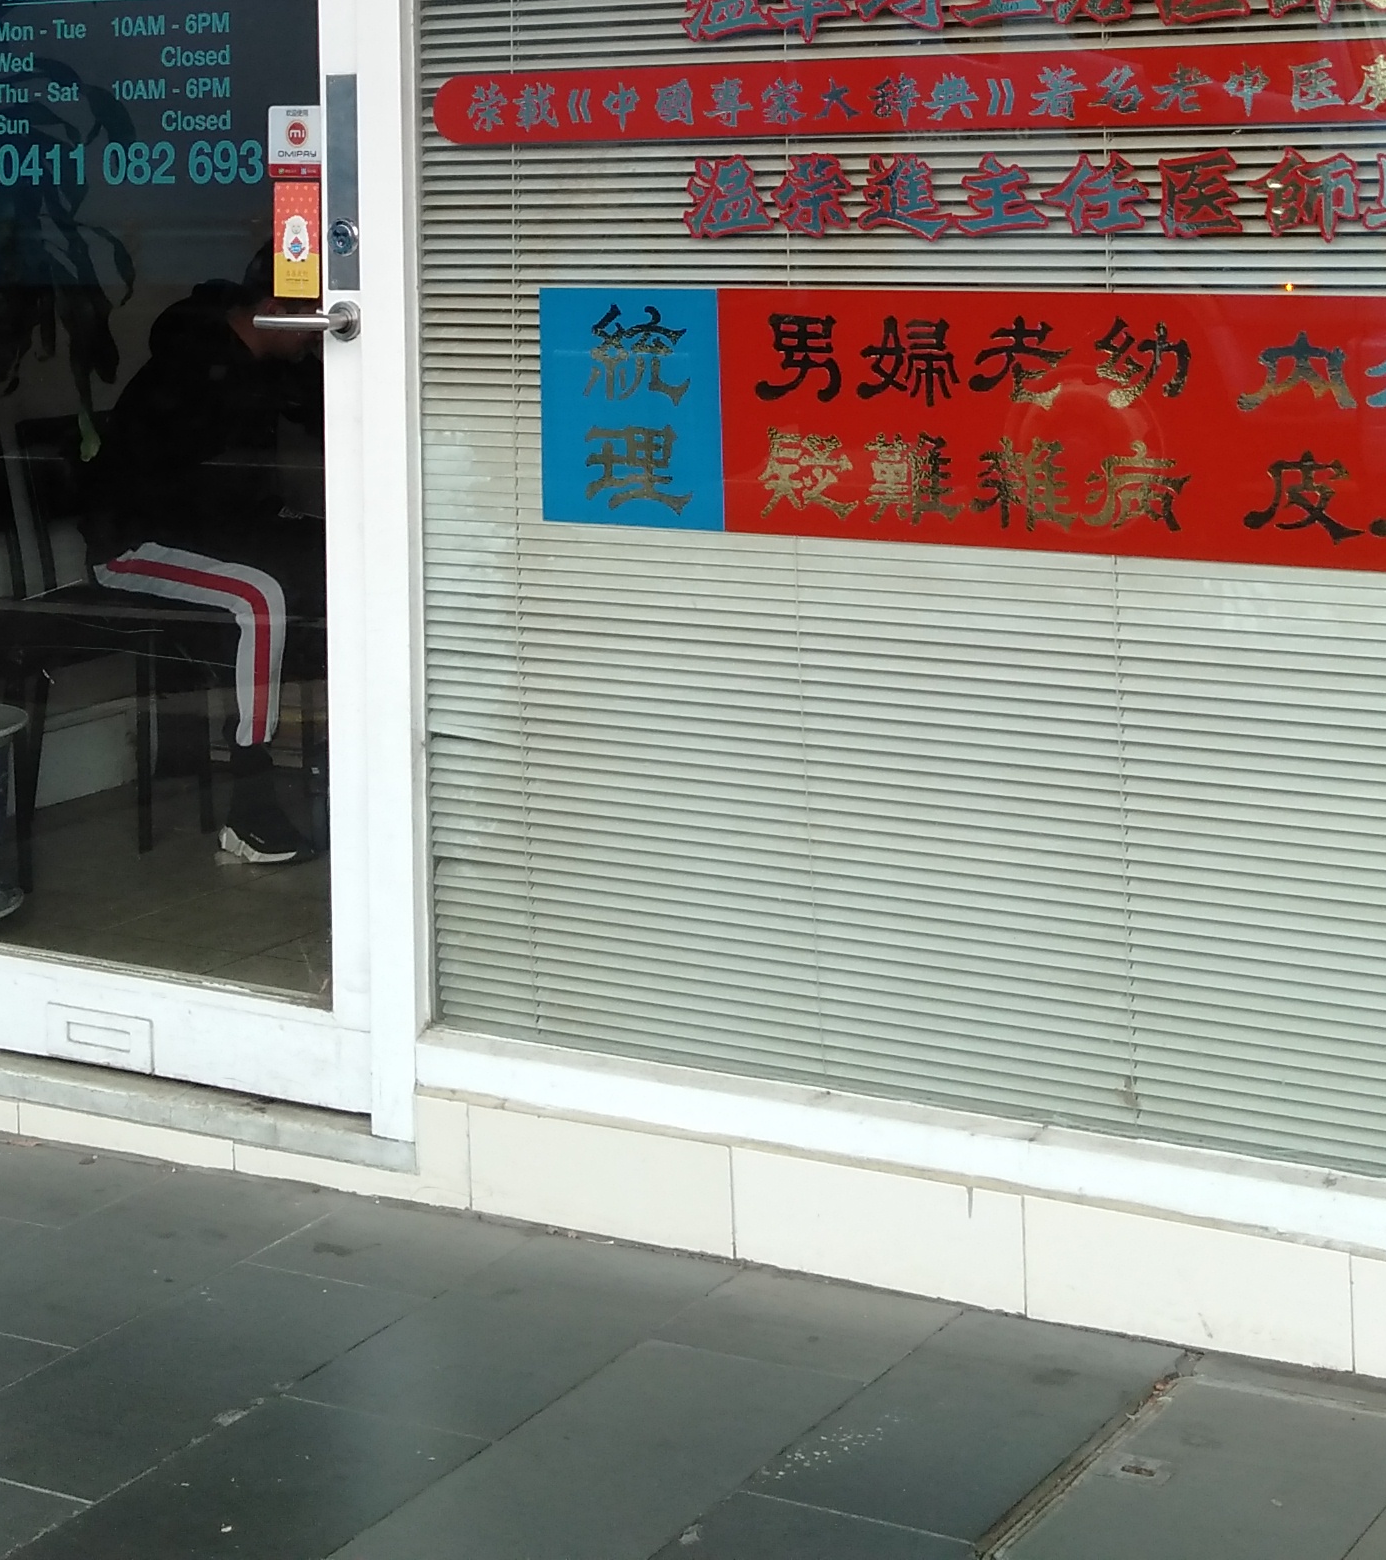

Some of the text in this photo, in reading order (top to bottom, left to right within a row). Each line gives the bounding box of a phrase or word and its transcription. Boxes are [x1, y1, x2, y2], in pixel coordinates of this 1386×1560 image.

[51, 18, 86, 40] Tue
[111, 16, 166, 38] 10AM
[185, 13, 230, 35] 6PM
[161, 45, 230, 68] Closed
[46, 81, 79, 102] Sat
[112, 79, 166, 100] 10AM
[185, 77, 230, 99] 6PM
[161, 110, 231, 131] Closed
[103, 141, 175, 184] 082
[188, 139, 263, 184] 693
[277, 150, 317, 158] OMIPAY
